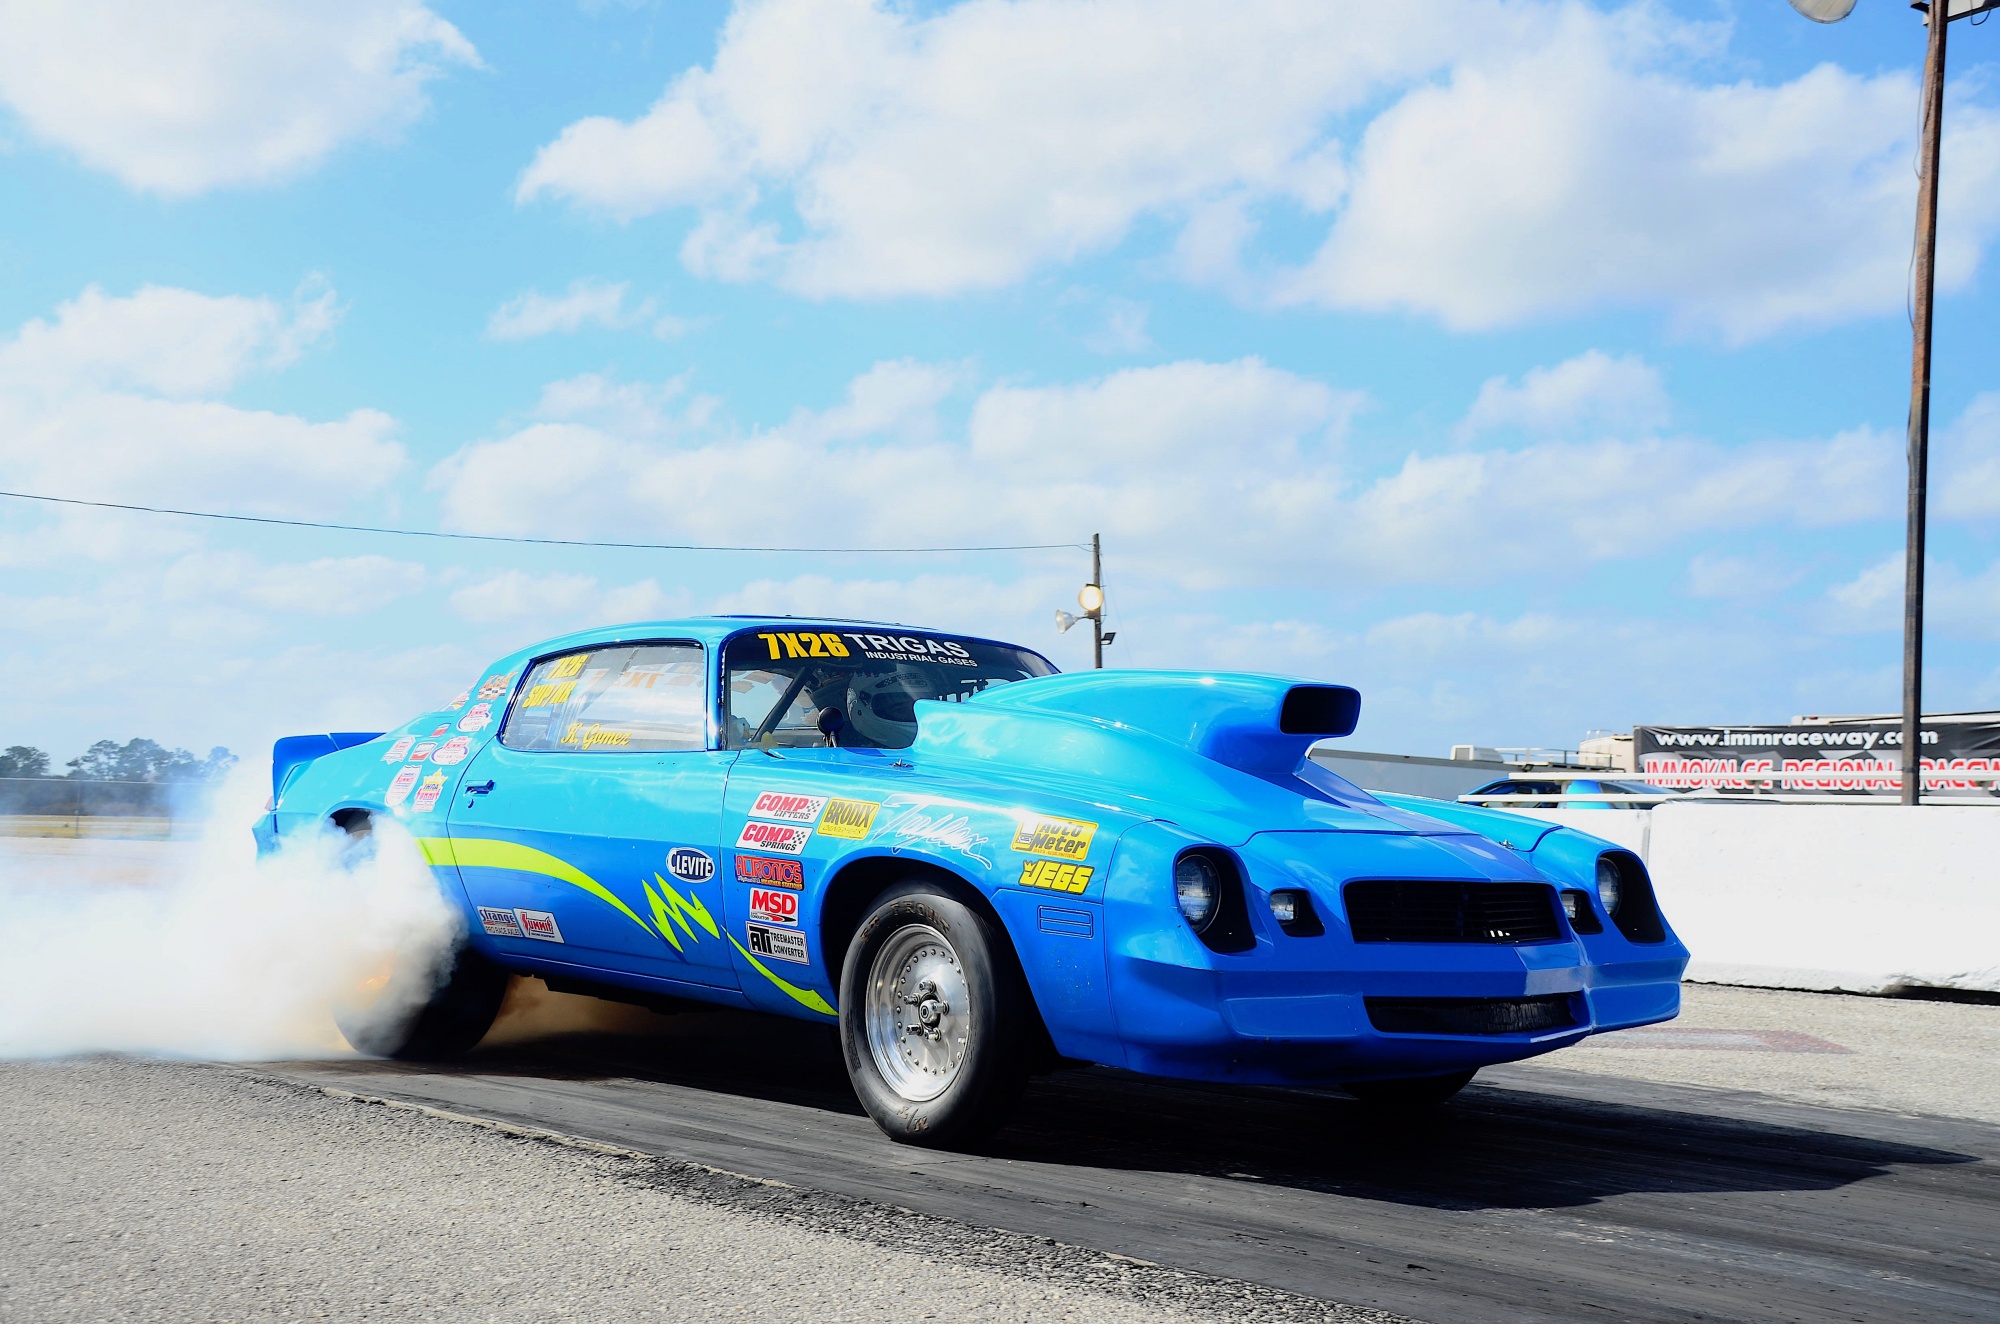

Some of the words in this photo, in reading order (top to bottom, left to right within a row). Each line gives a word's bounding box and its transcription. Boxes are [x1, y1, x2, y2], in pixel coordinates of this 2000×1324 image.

[758, 632, 850, 660] 7X26
[843, 633, 970, 658] TRIGAS
[864, 651, 938, 664] INDUSTRIAL
[938, 656, 978, 668] GASES
[1645, 758, 1773, 790] IMMOKALEE
[1780, 758, 1904, 791] REGIONAL
[755, 794, 809, 812] COMP
[773, 809, 811, 820] LIFTERS
[823, 801, 876, 829] BRODIX
[742, 824, 795, 843] COMP
[1039, 819, 1084, 838] Auto
[760, 840, 798, 851] SPRINGS
[1032, 833, 1087, 855] Meter
[667, 848, 714, 878] CLEVITE
[1018, 859, 1095, 895] JEGS
[751, 890, 797, 915] MSD
[479, 908, 516, 924] Strange
[749, 926, 773, 955] ATI
[770, 932, 805, 947] TREEMASTER
[773, 944, 805, 959] CONVERTER
